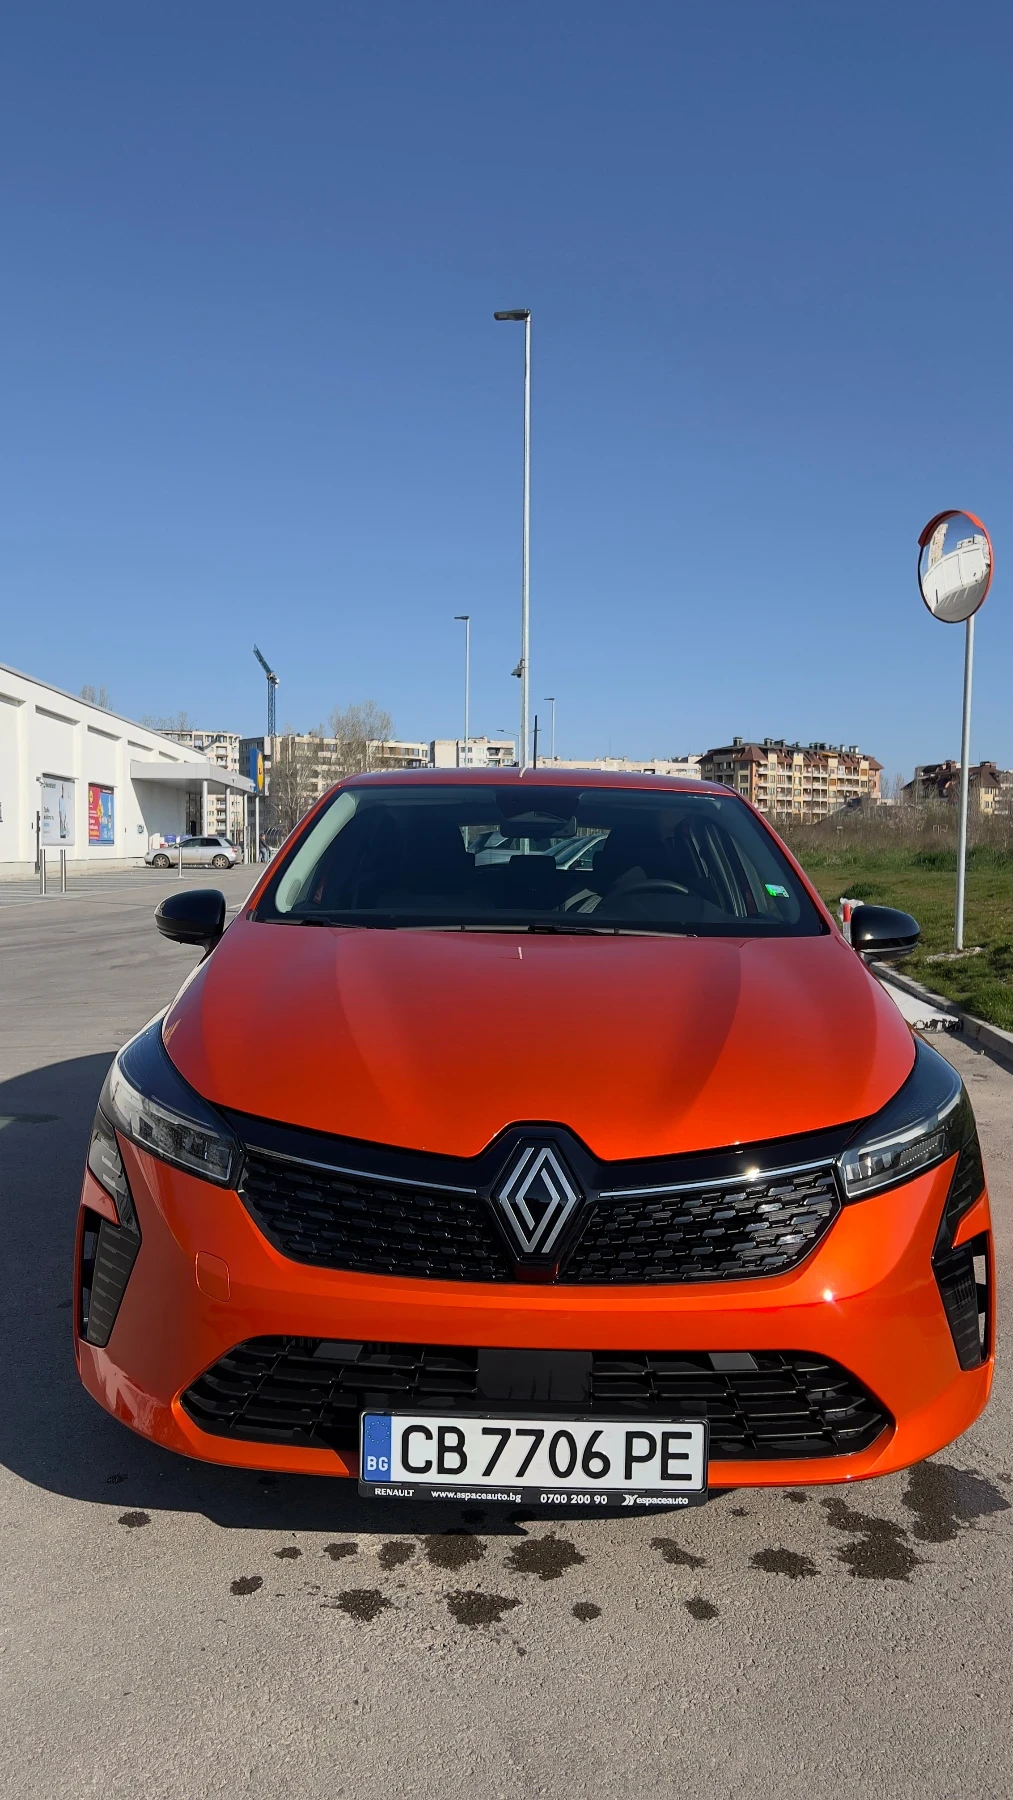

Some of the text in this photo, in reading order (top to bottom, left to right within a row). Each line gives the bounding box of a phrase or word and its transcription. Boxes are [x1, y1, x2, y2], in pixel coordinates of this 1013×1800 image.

[401, 1424, 693, 1481] CB 7706 PE
[367, 1455, 389, 1472] BG
[374, 1487, 415, 1497] RENAULT
[430, 1490, 522, 1503] www.espaceauto.bg
[540, 1494, 608, 1505] 0700 200 90
[636, 1496, 689, 1506] espaceauto
